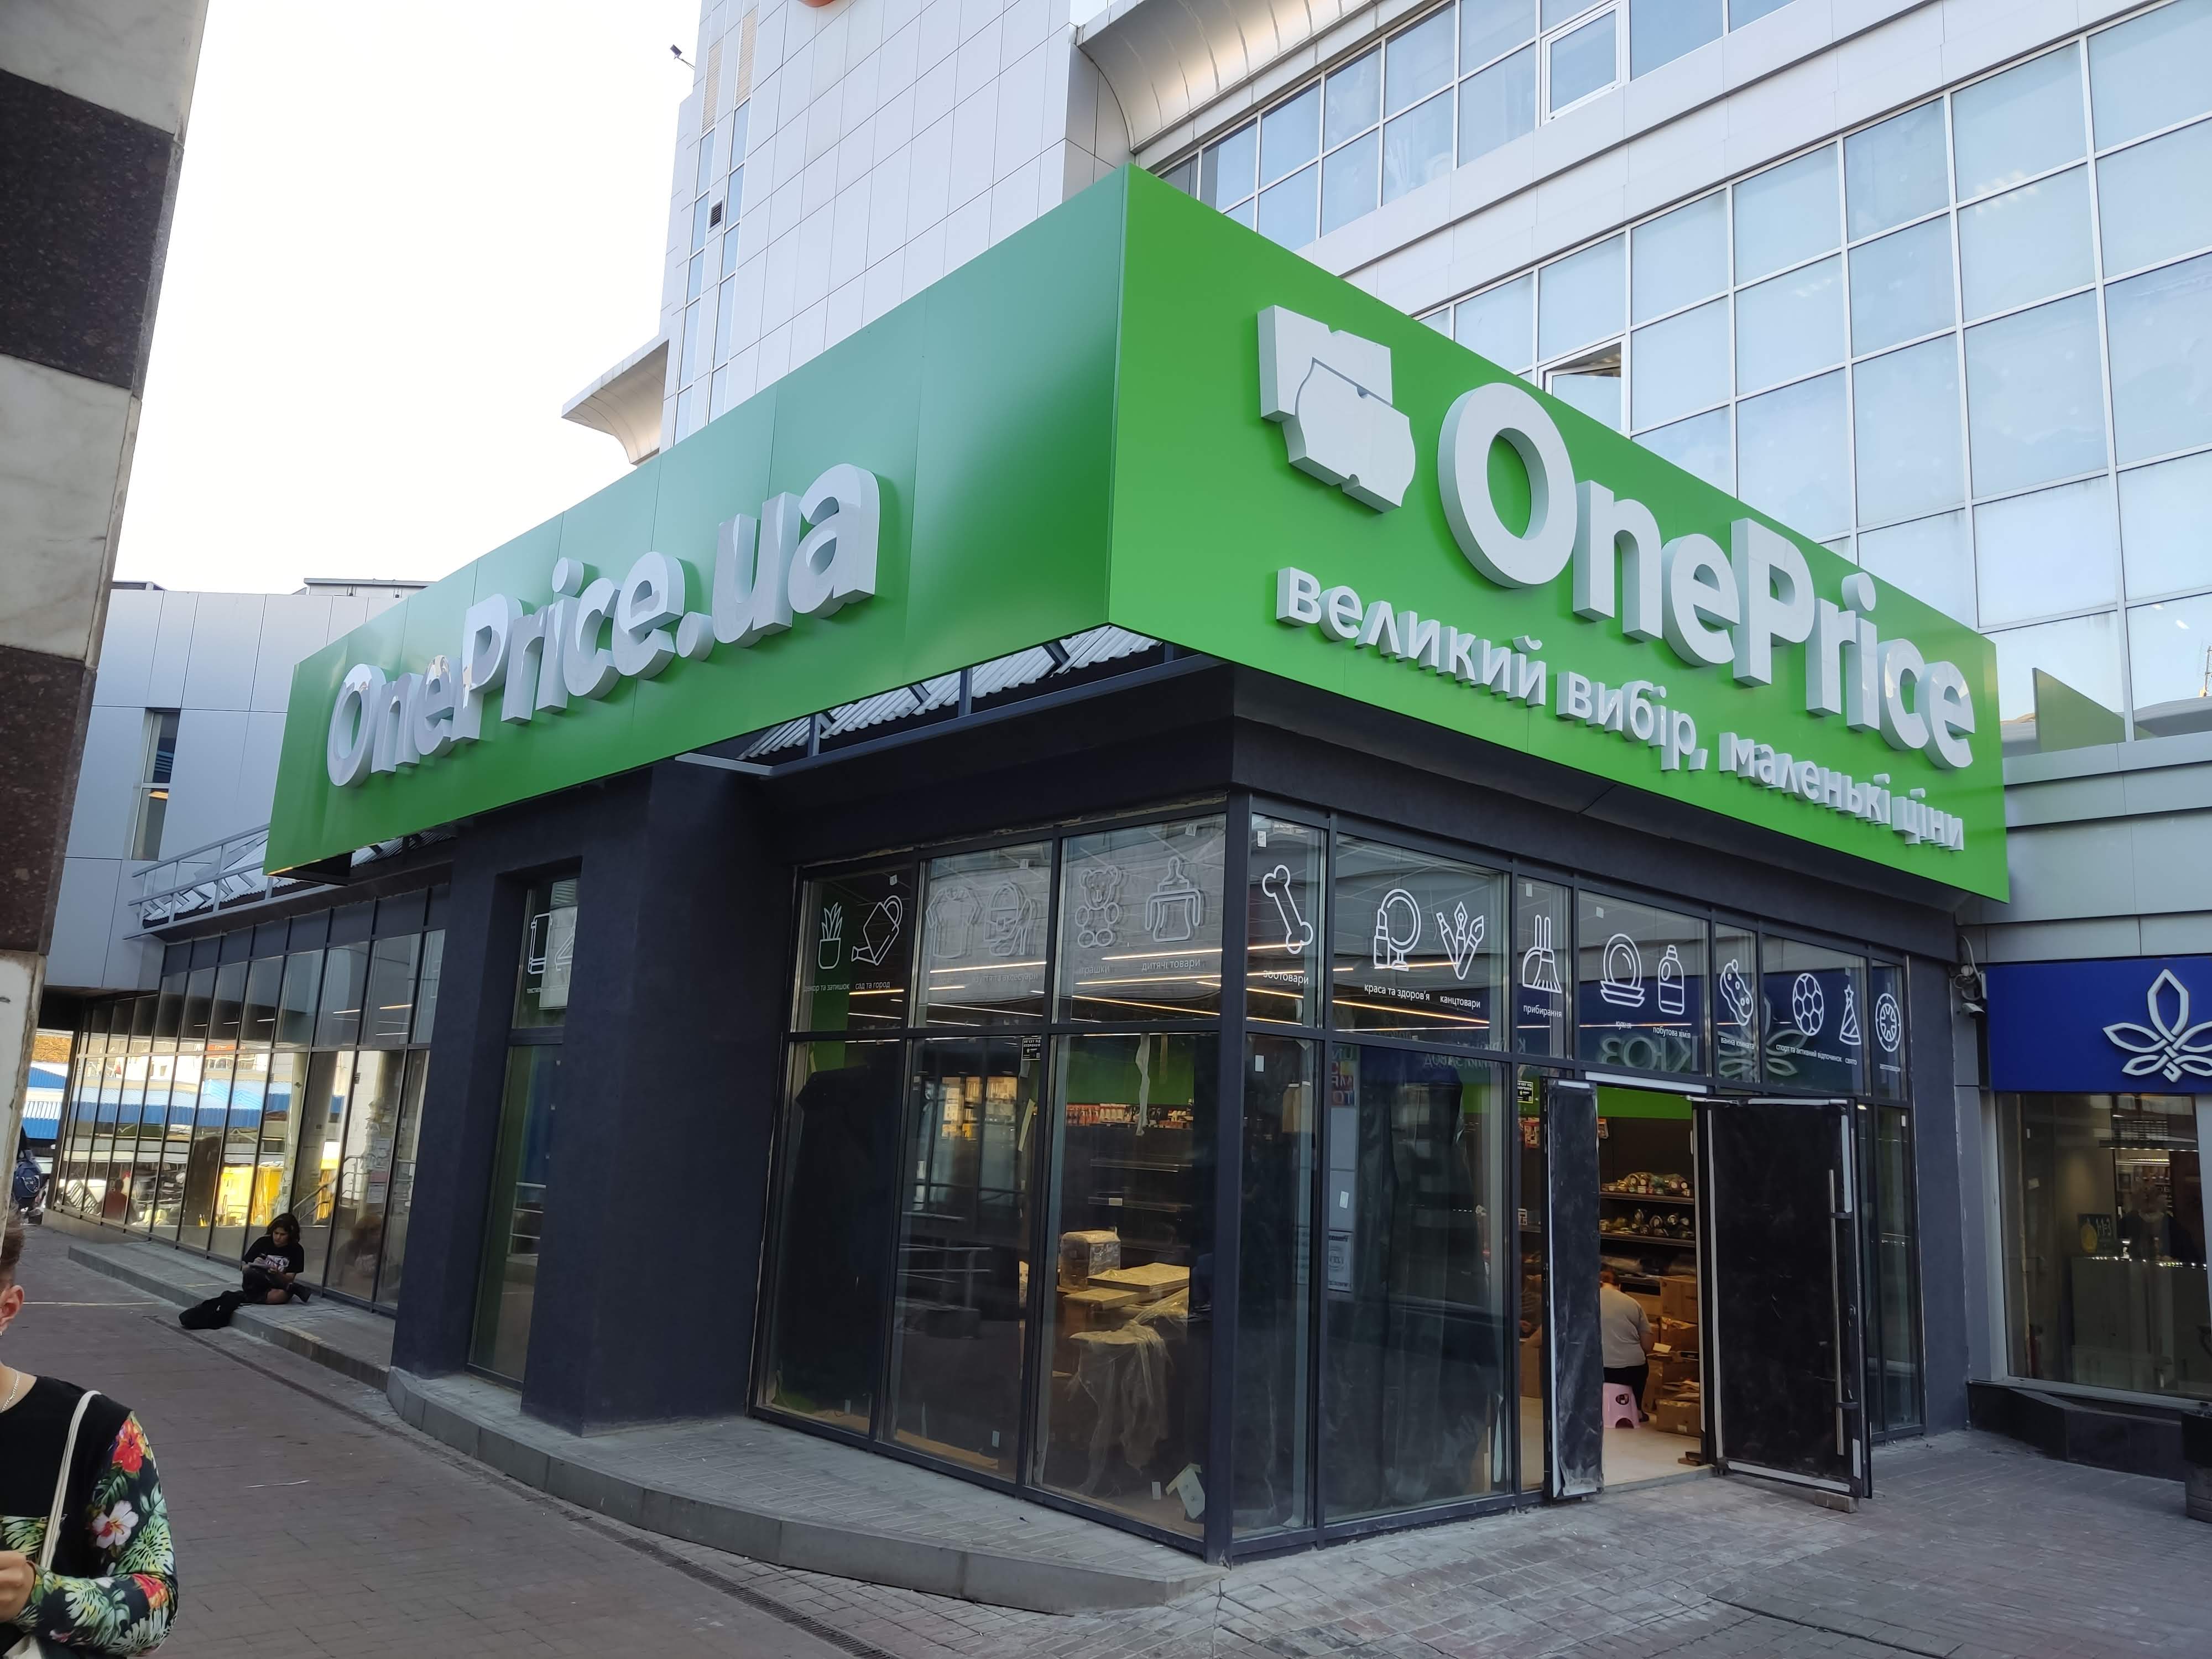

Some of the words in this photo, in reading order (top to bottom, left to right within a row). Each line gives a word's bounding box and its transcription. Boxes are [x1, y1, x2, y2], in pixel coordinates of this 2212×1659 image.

[1438, 383, 1975, 769] OnePrice
[327, 463, 881, 787] OnePrice.ua
[1276, 567, 1547, 707] великий
[1556, 671, 1708, 771] вибір,
[1719, 732, 1892, 825] маленькі
[1892, 787, 1964, 851] ціни
[1141, 960, 1168, 972] дитячі
[1170, 959, 1201, 969] товари
[873, 981, 890, 990] город
[1262, 970, 1309, 986] зоотовари
[1364, 984, 1386, 995] краса
[1387, 987, 1396, 995] та
[1397, 989, 1430, 1001] здоров'я
[1440, 995, 1481, 1010] канцтовари
[1523, 1004, 1562, 1019] прибирання
[1653, 1025, 1678, 1037] побутова
[1776, 1044, 1790, 1053] спорт
